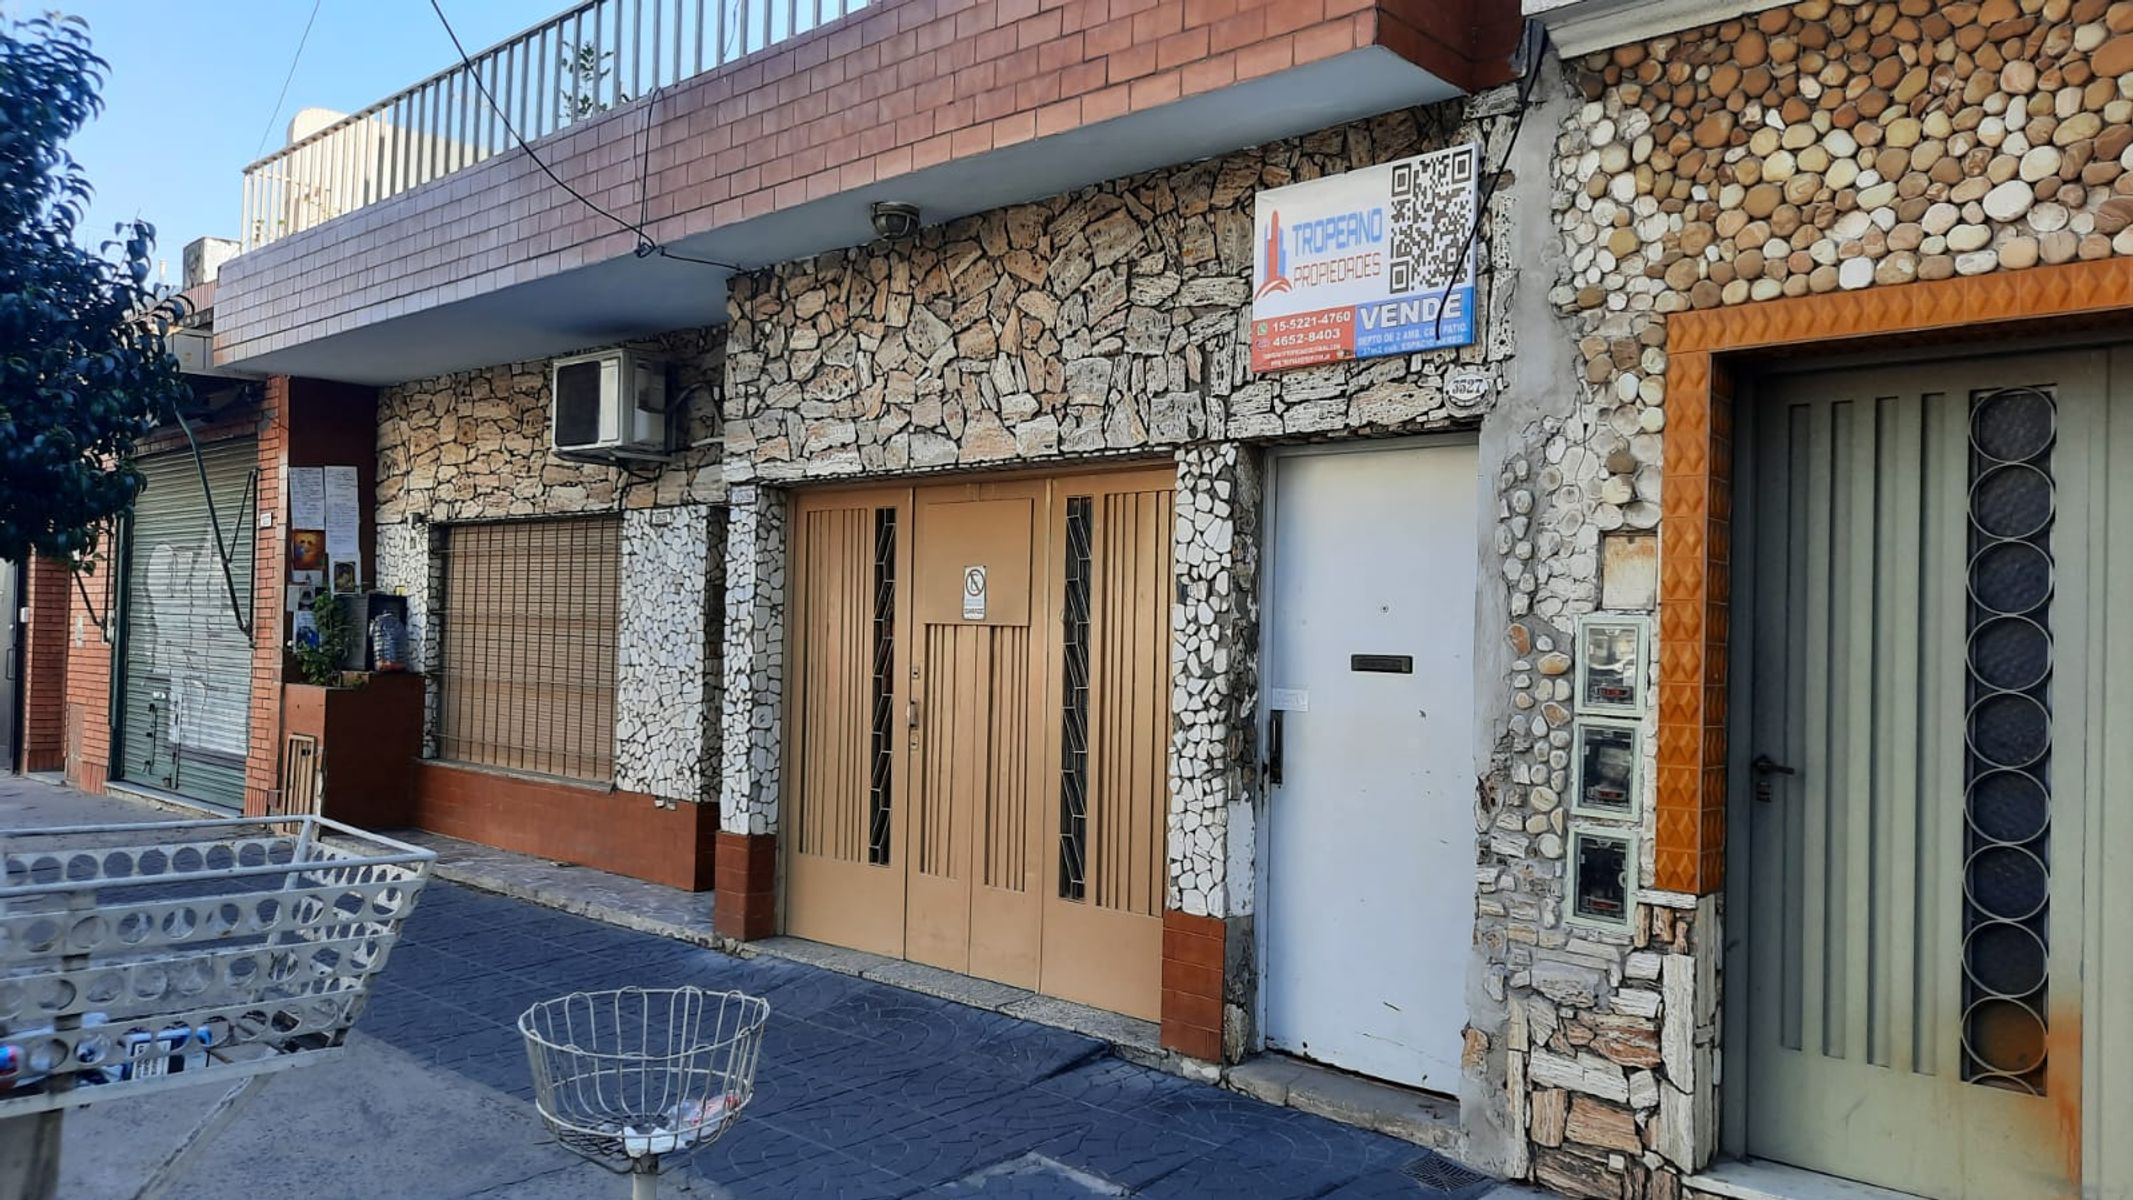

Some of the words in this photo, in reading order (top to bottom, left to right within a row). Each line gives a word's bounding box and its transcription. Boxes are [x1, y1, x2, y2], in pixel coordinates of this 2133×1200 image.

[1292, 207, 1382, 257] TROPEANO
[1294, 252, 1380, 288] PROPIEDADES
[1273, 311, 1350, 332] 15-5221-4760
[1359, 293, 1462, 330] VENDE
[1273, 328, 1340, 346] 4652-8403
